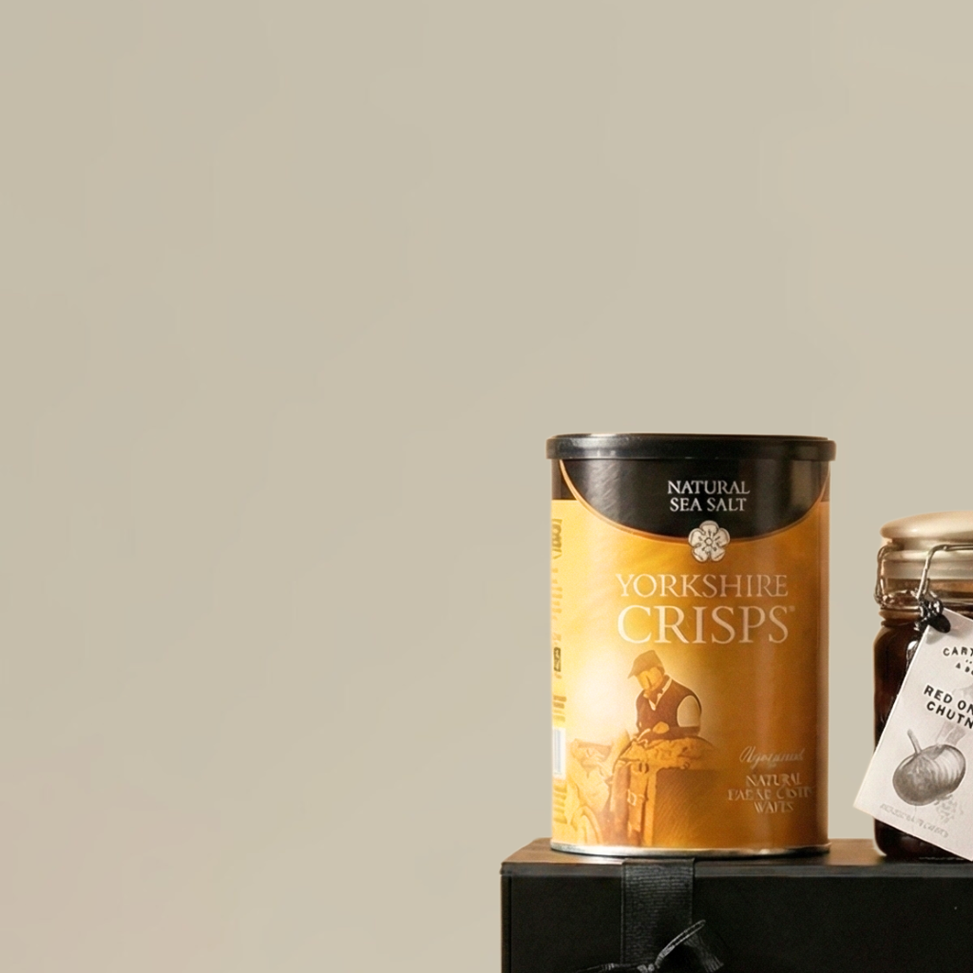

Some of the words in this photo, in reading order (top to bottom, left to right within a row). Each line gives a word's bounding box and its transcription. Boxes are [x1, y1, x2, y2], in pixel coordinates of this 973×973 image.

[667, 480, 750, 495] NATURAL
[669, 497, 703, 512] SEA
[706, 497, 747, 512] SALT
[615, 573, 788, 598] YORKSHIRE
[617, 604, 789, 645] CRISPS
[923, 684, 953, 704] RED
